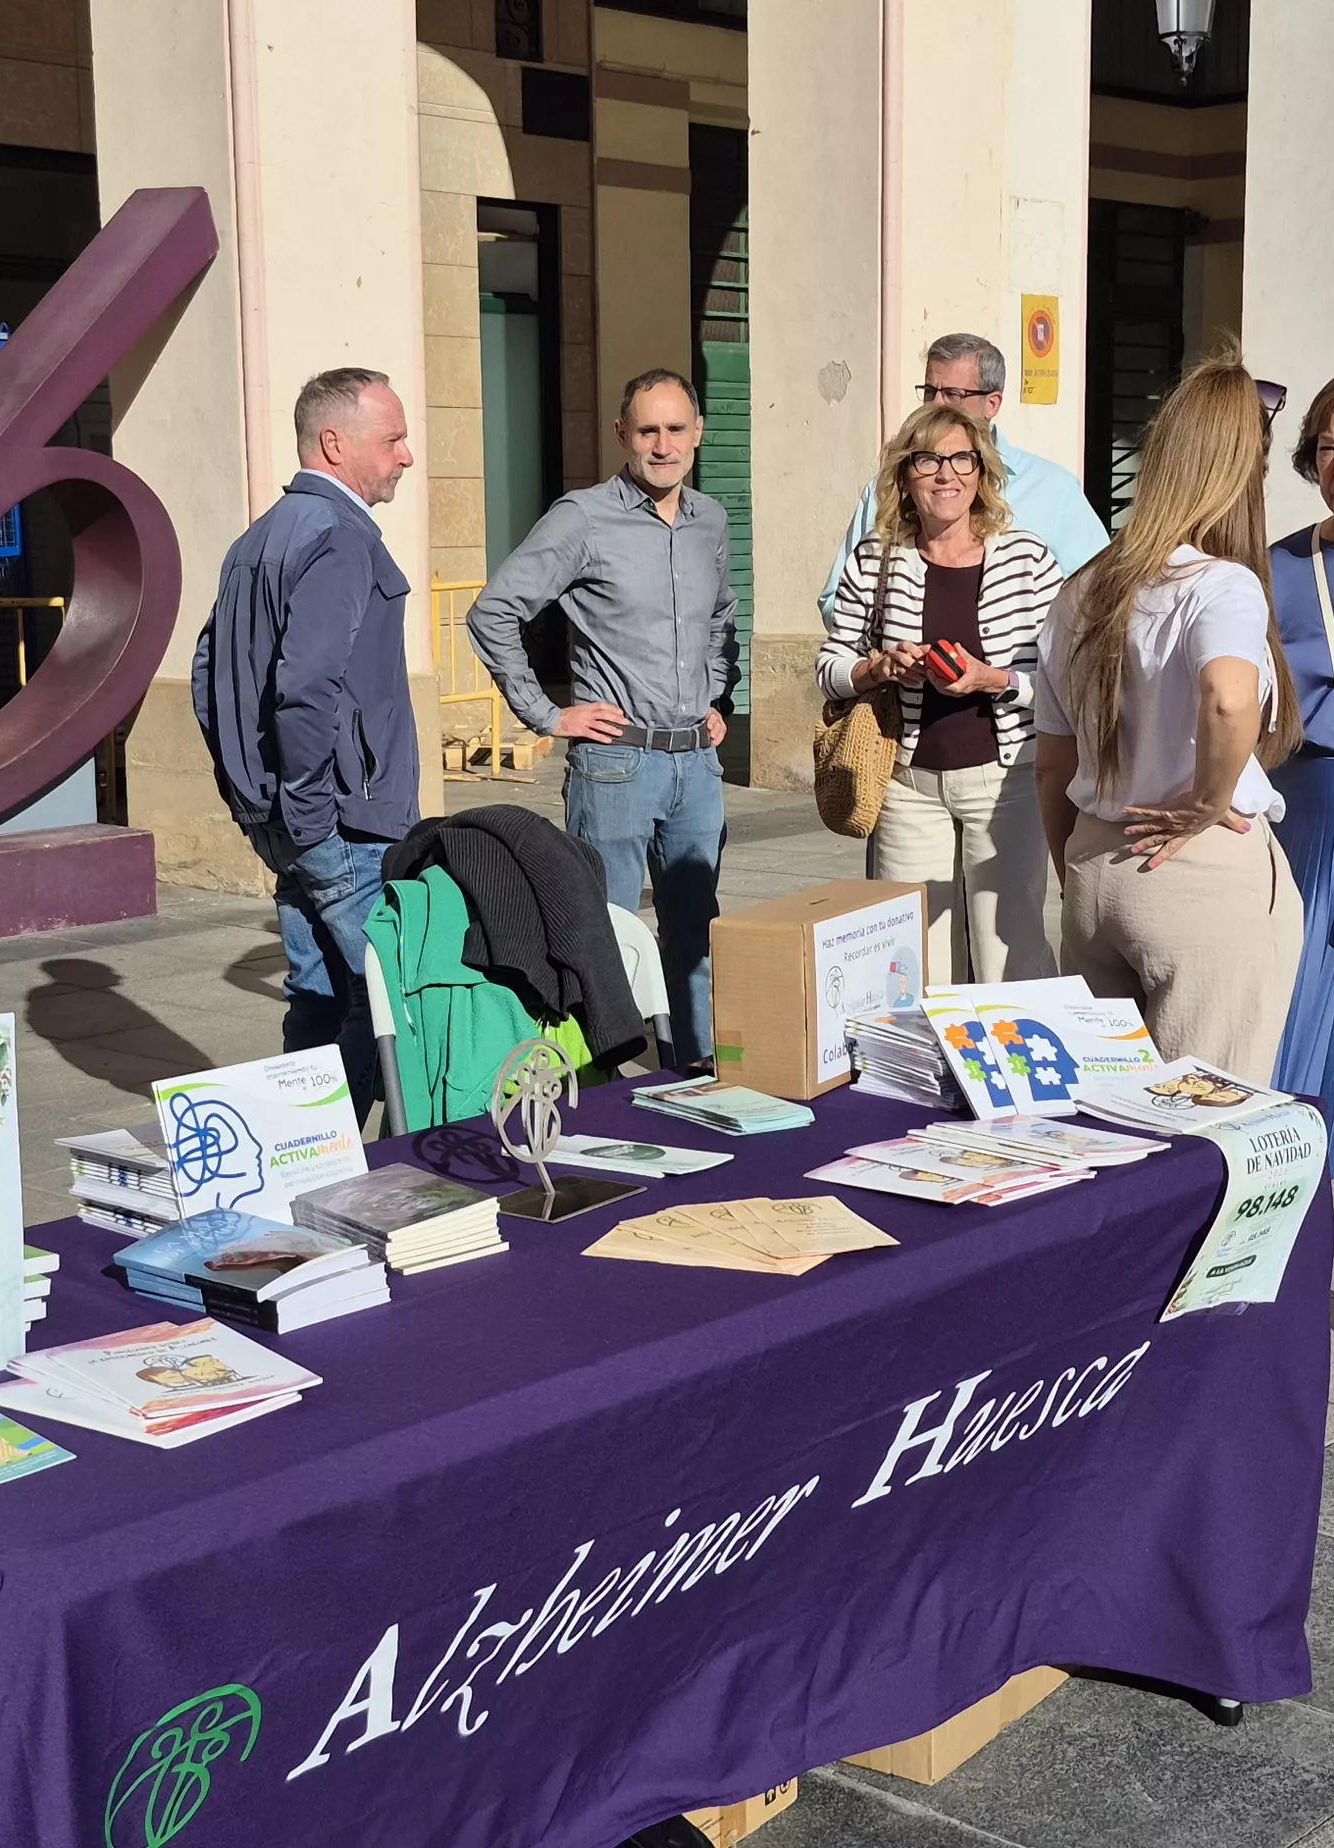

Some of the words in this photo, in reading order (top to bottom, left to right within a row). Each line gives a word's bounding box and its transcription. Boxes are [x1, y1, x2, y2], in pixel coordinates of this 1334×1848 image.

[836, 927, 865, 946] memoria
[866, 924, 878, 936] con
[879, 921, 886, 931] tu
[887, 911, 914, 928] donativo
[843, 944, 873, 963] Recordar
[873, 944, 879, 953] es
[880, 937, 896, 950] vivir
[278, 1076, 307, 1089] Mente
[310, 1074, 338, 1087] 100%
[274, 1130, 338, 1152] CUADERNILLO
[1249, 1125, 1301, 1153] LOTERÍA
[1247, 1155, 1262, 1175] DE
[1265, 1142, 1312, 1169] NAVIDAD
[1233, 1185, 1299, 1222] 98.148
[287, 1473, 820, 1785] Alzheimer
[851, 1339, 1150, 1512] Huesca
